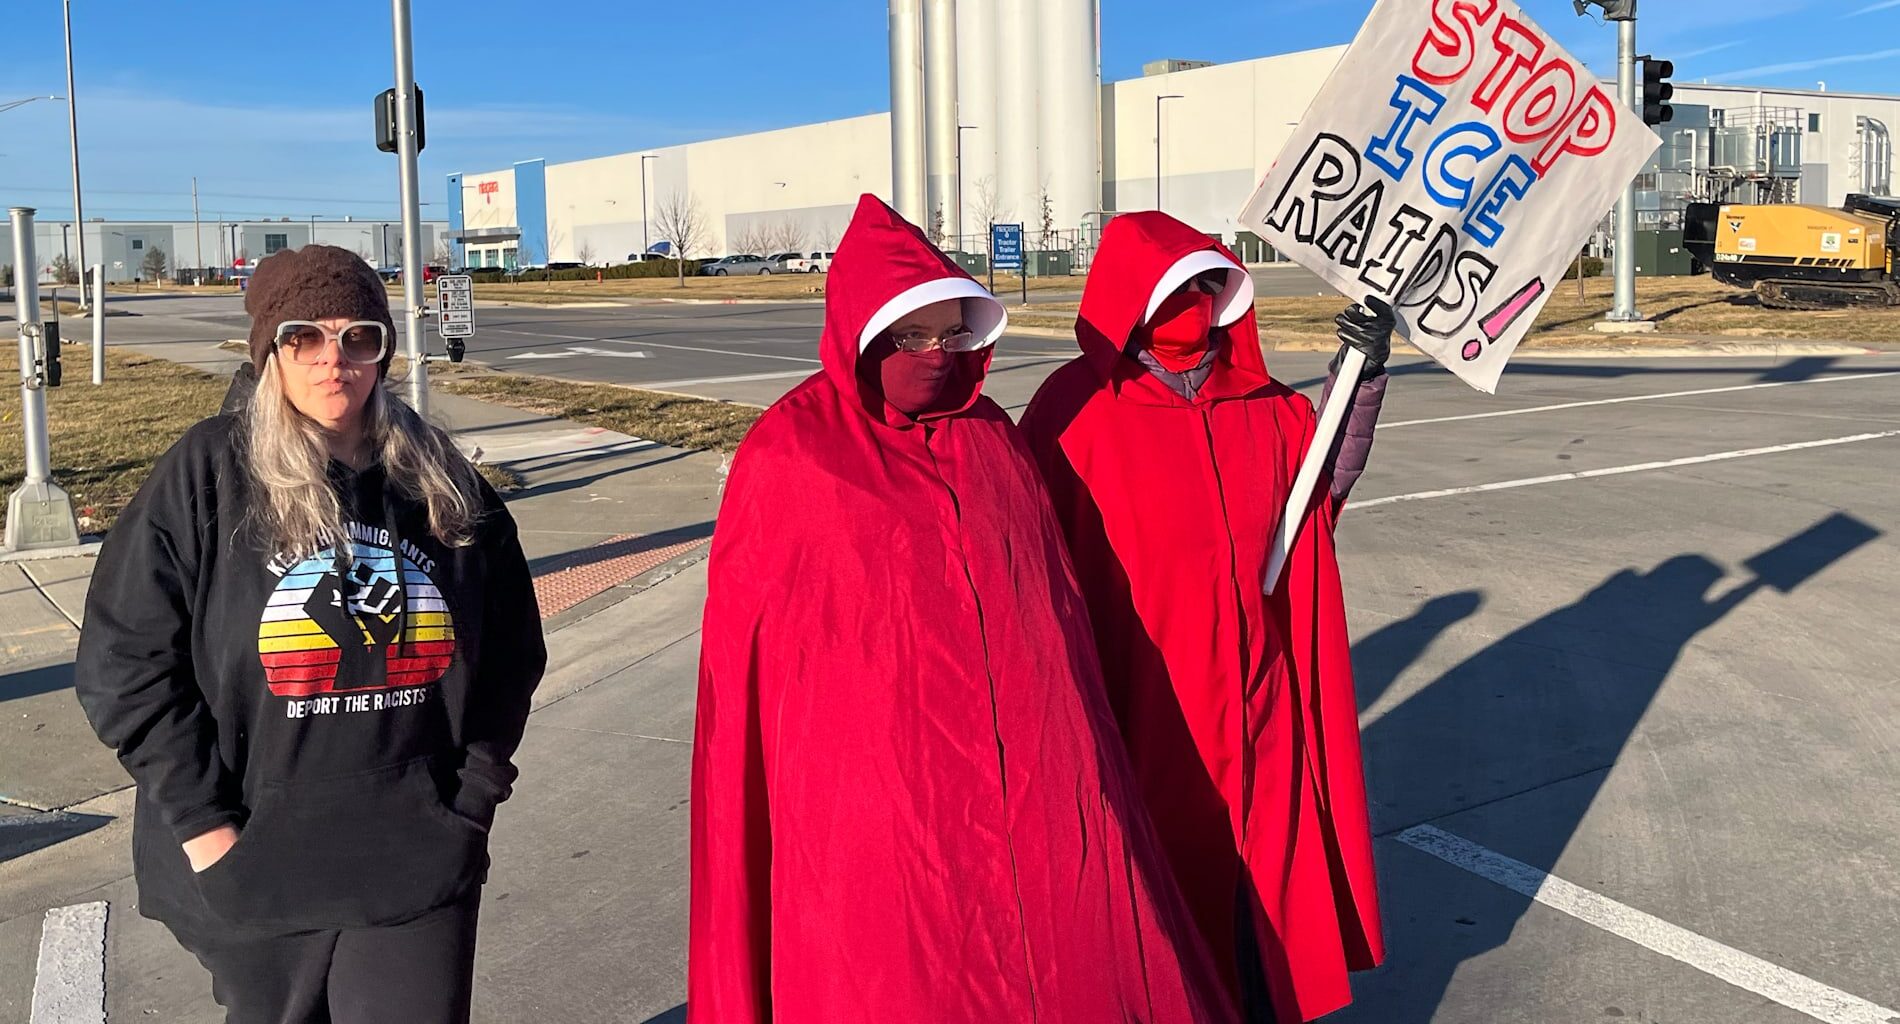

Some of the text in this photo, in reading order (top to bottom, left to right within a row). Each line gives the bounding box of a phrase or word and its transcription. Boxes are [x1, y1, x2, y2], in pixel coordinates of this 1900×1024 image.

[1364, 74, 1541, 249] ICE
[1411, 0, 1617, 180] STOP
[1264, 132, 1546, 362] RAIDS!
[343, 521, 436, 574] IMMIGANTS
[286, 688, 427, 719] DEPORT THE RACISTS
